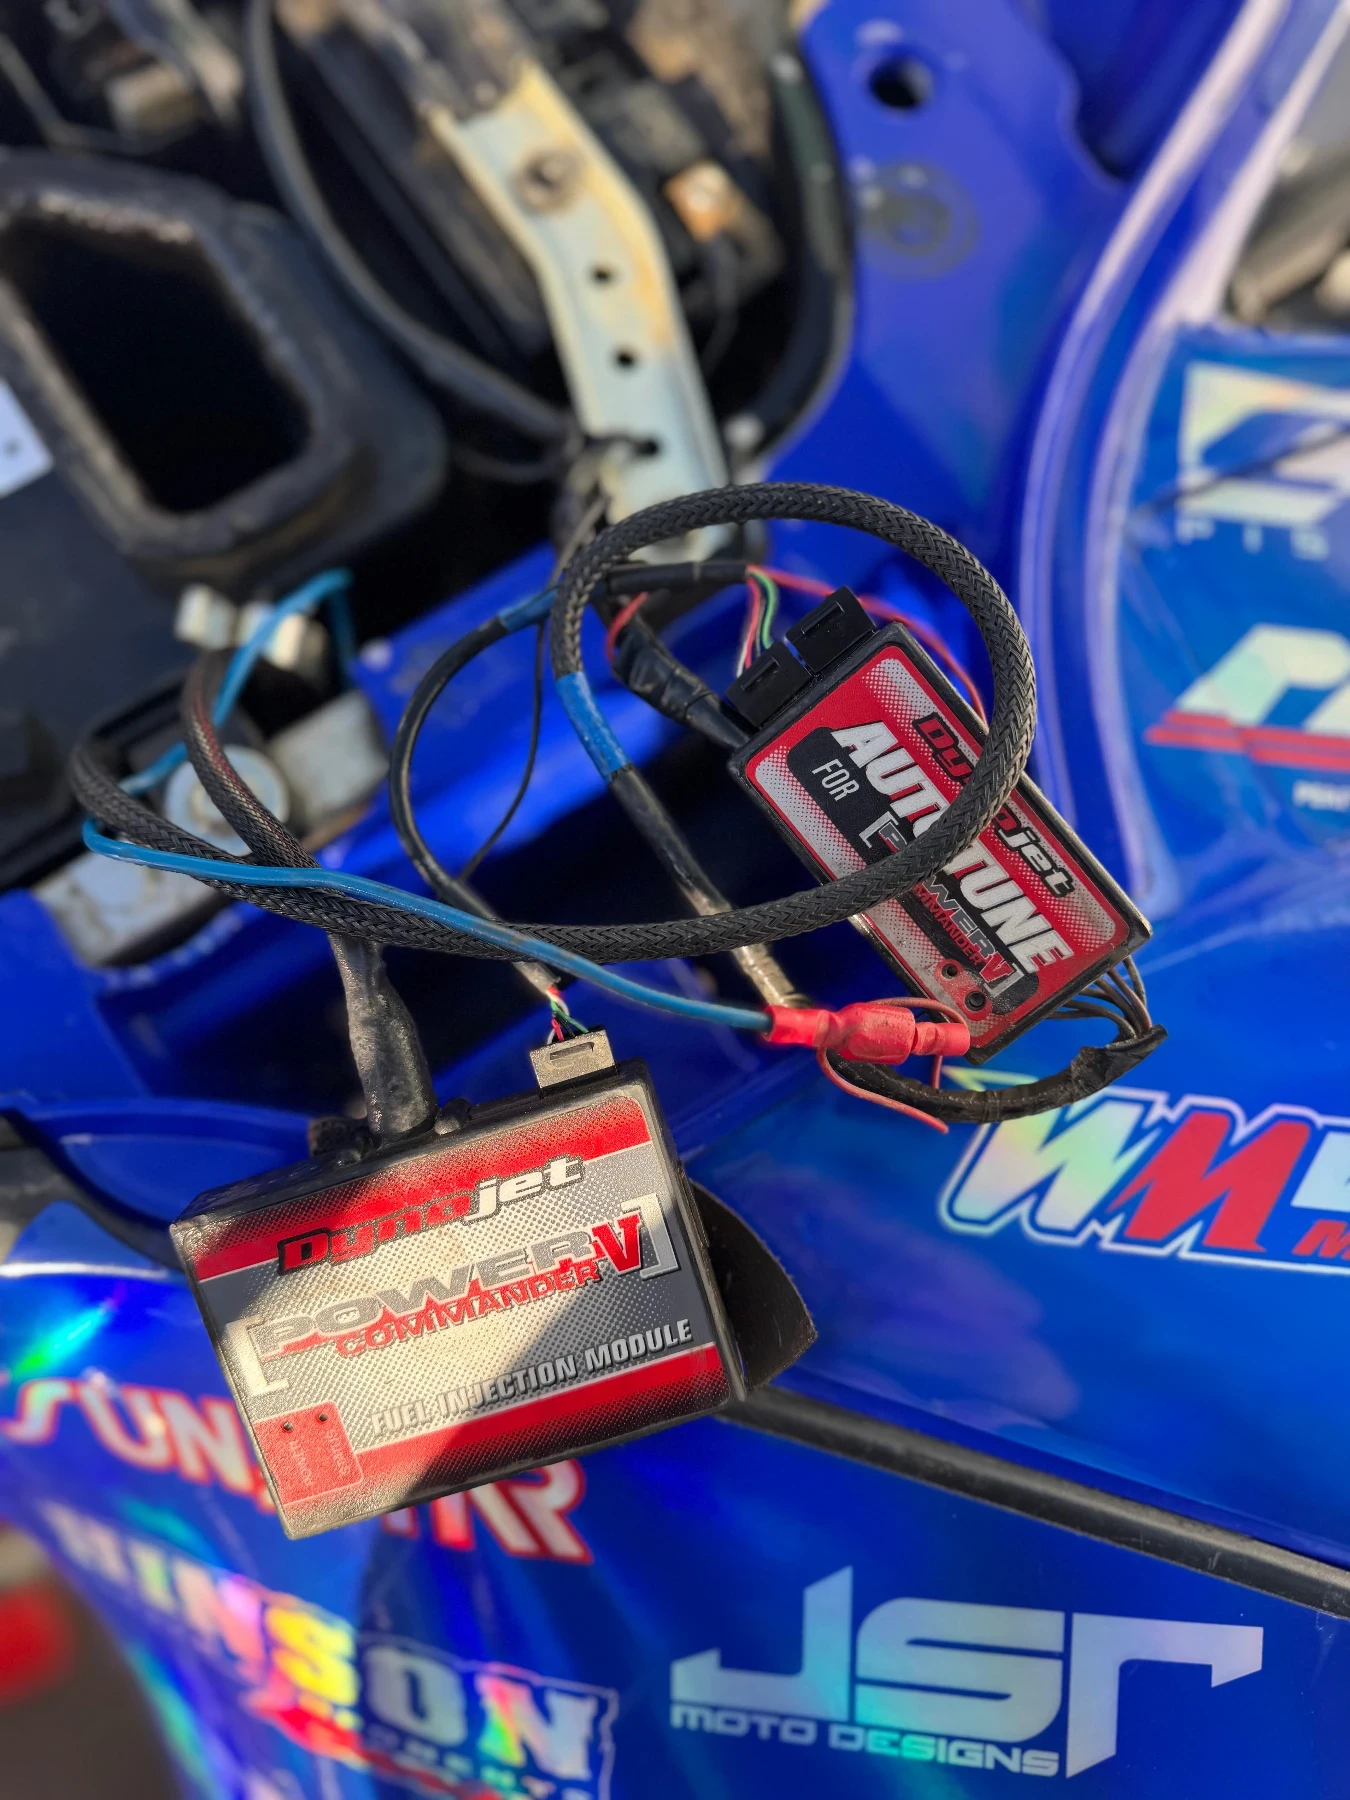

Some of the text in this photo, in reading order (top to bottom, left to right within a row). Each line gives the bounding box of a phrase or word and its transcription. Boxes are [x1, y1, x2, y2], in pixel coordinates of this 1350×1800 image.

[812, 758, 860, 801] FOR
[878, 821, 996, 959] PWER
[277, 1153, 586, 1276] Dynojet
[259, 1214, 643, 1355] POWER V
[336, 1260, 600, 1360] COMMANDER
[370, 1318, 693, 1438] FUEL INJECTION MODULE
[671, 1704, 1059, 1777] MOTO DESIGNS
